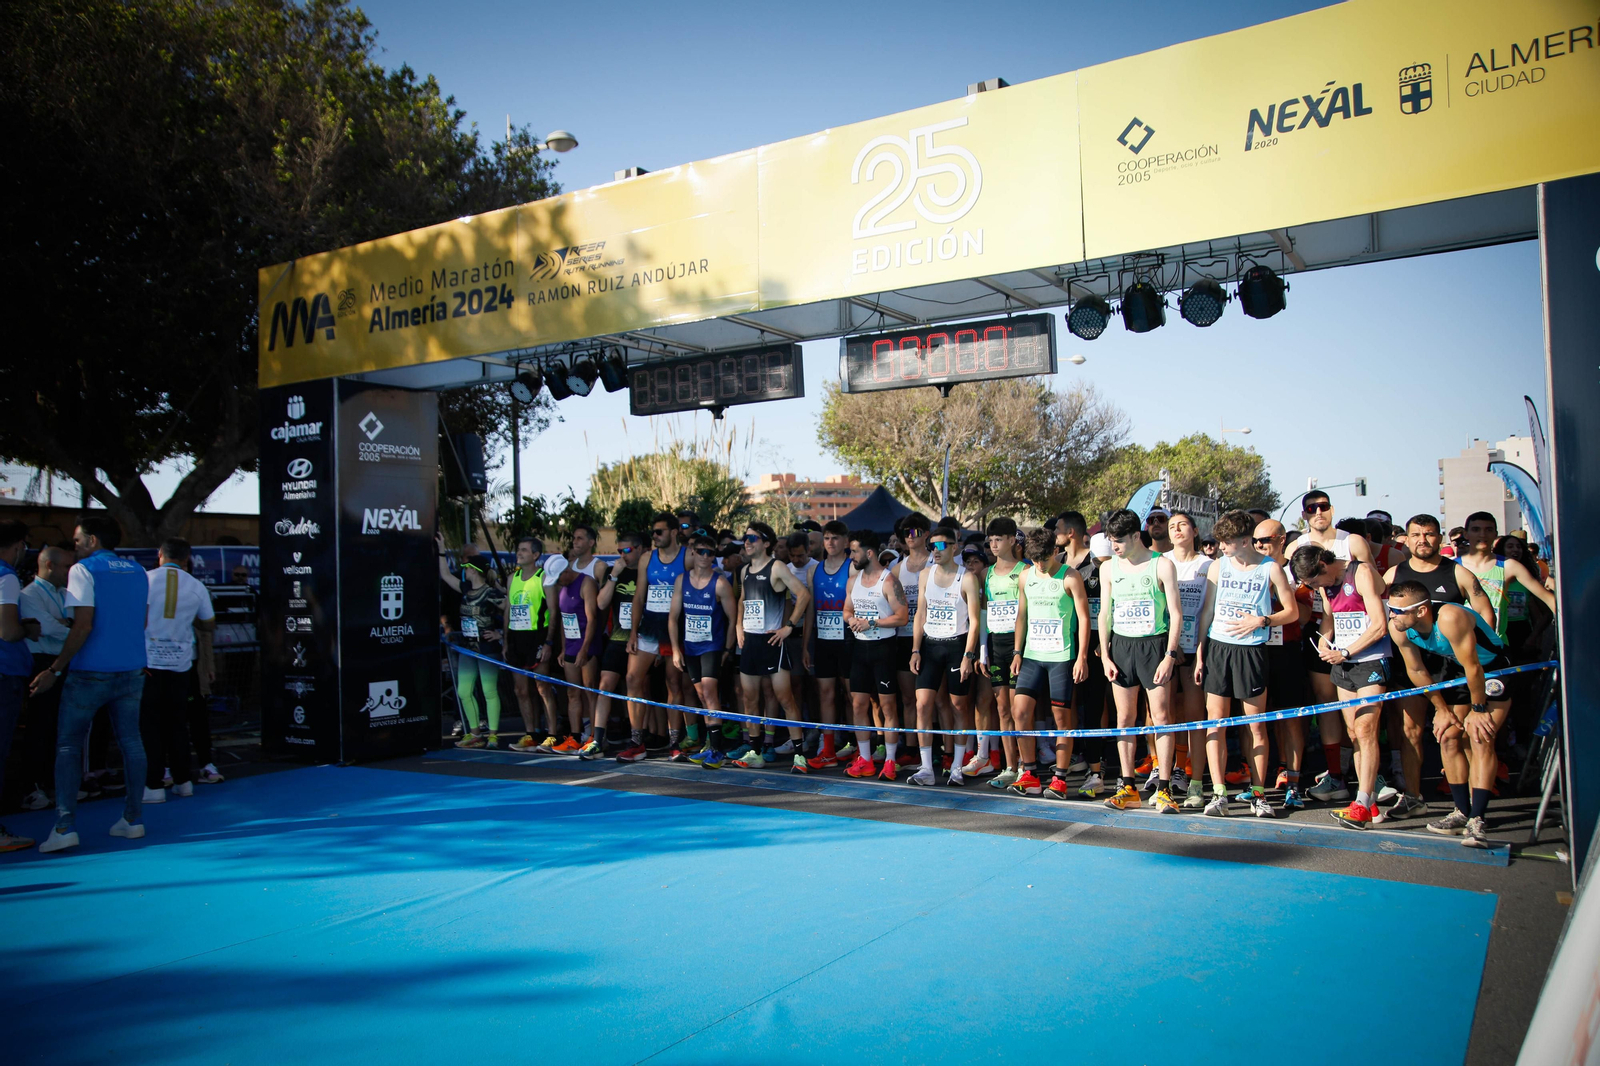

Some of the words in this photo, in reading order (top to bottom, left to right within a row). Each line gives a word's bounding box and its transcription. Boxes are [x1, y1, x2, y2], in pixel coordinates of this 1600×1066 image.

[1465, 67, 1546, 97] CIUDAD
[1244, 80, 1373, 152] NEXAL
[1254, 138, 1279, 150] 2020
[1117, 144, 1218, 174] COOPERACIÓN
[1153, 165, 1179, 174] Deporte,
[1200, 156, 1221, 165] cultura
[851, 116, 983, 240] 25
[1117, 170, 1151, 186] 2005
[569, 241, 607, 256] RFEA
[852, 228, 984, 276] EDICIÓN
[563, 264, 586, 276] RUTA
[587, 258, 625, 272] RUNNING
[566, 253, 602, 266] SERIES
[370, 274, 424, 303] Medio
[431, 257, 514, 291] Maratón
[527, 282, 581, 306] RAMÓN
[587, 275, 625, 295] RUIZ
[631, 258, 709, 287] ANDÚJAR
[338, 288, 356, 311] 25
[369, 294, 447, 334] Almería
[452, 283, 515, 318] 2024
[271, 421, 323, 444] cajamar
[358, 441, 420, 456] COOPERACIÓN
[359, 451, 380, 462] 2005
[282, 480, 317, 491] HYUNDAI
[362, 505, 421, 535] NEXAL
[1221, 578, 1262, 594] nerja
[651, 590, 674, 599] 5610
[929, 610, 953, 620] 5492
[991, 605, 1016, 616] 5553
[687, 620, 708, 629] 5784
[818, 616, 840, 625] 5770
[370, 623, 414, 638] ALMERÍA
[1032, 624, 1058, 635] 5707
[381, 636, 404, 644] CIUDAD
